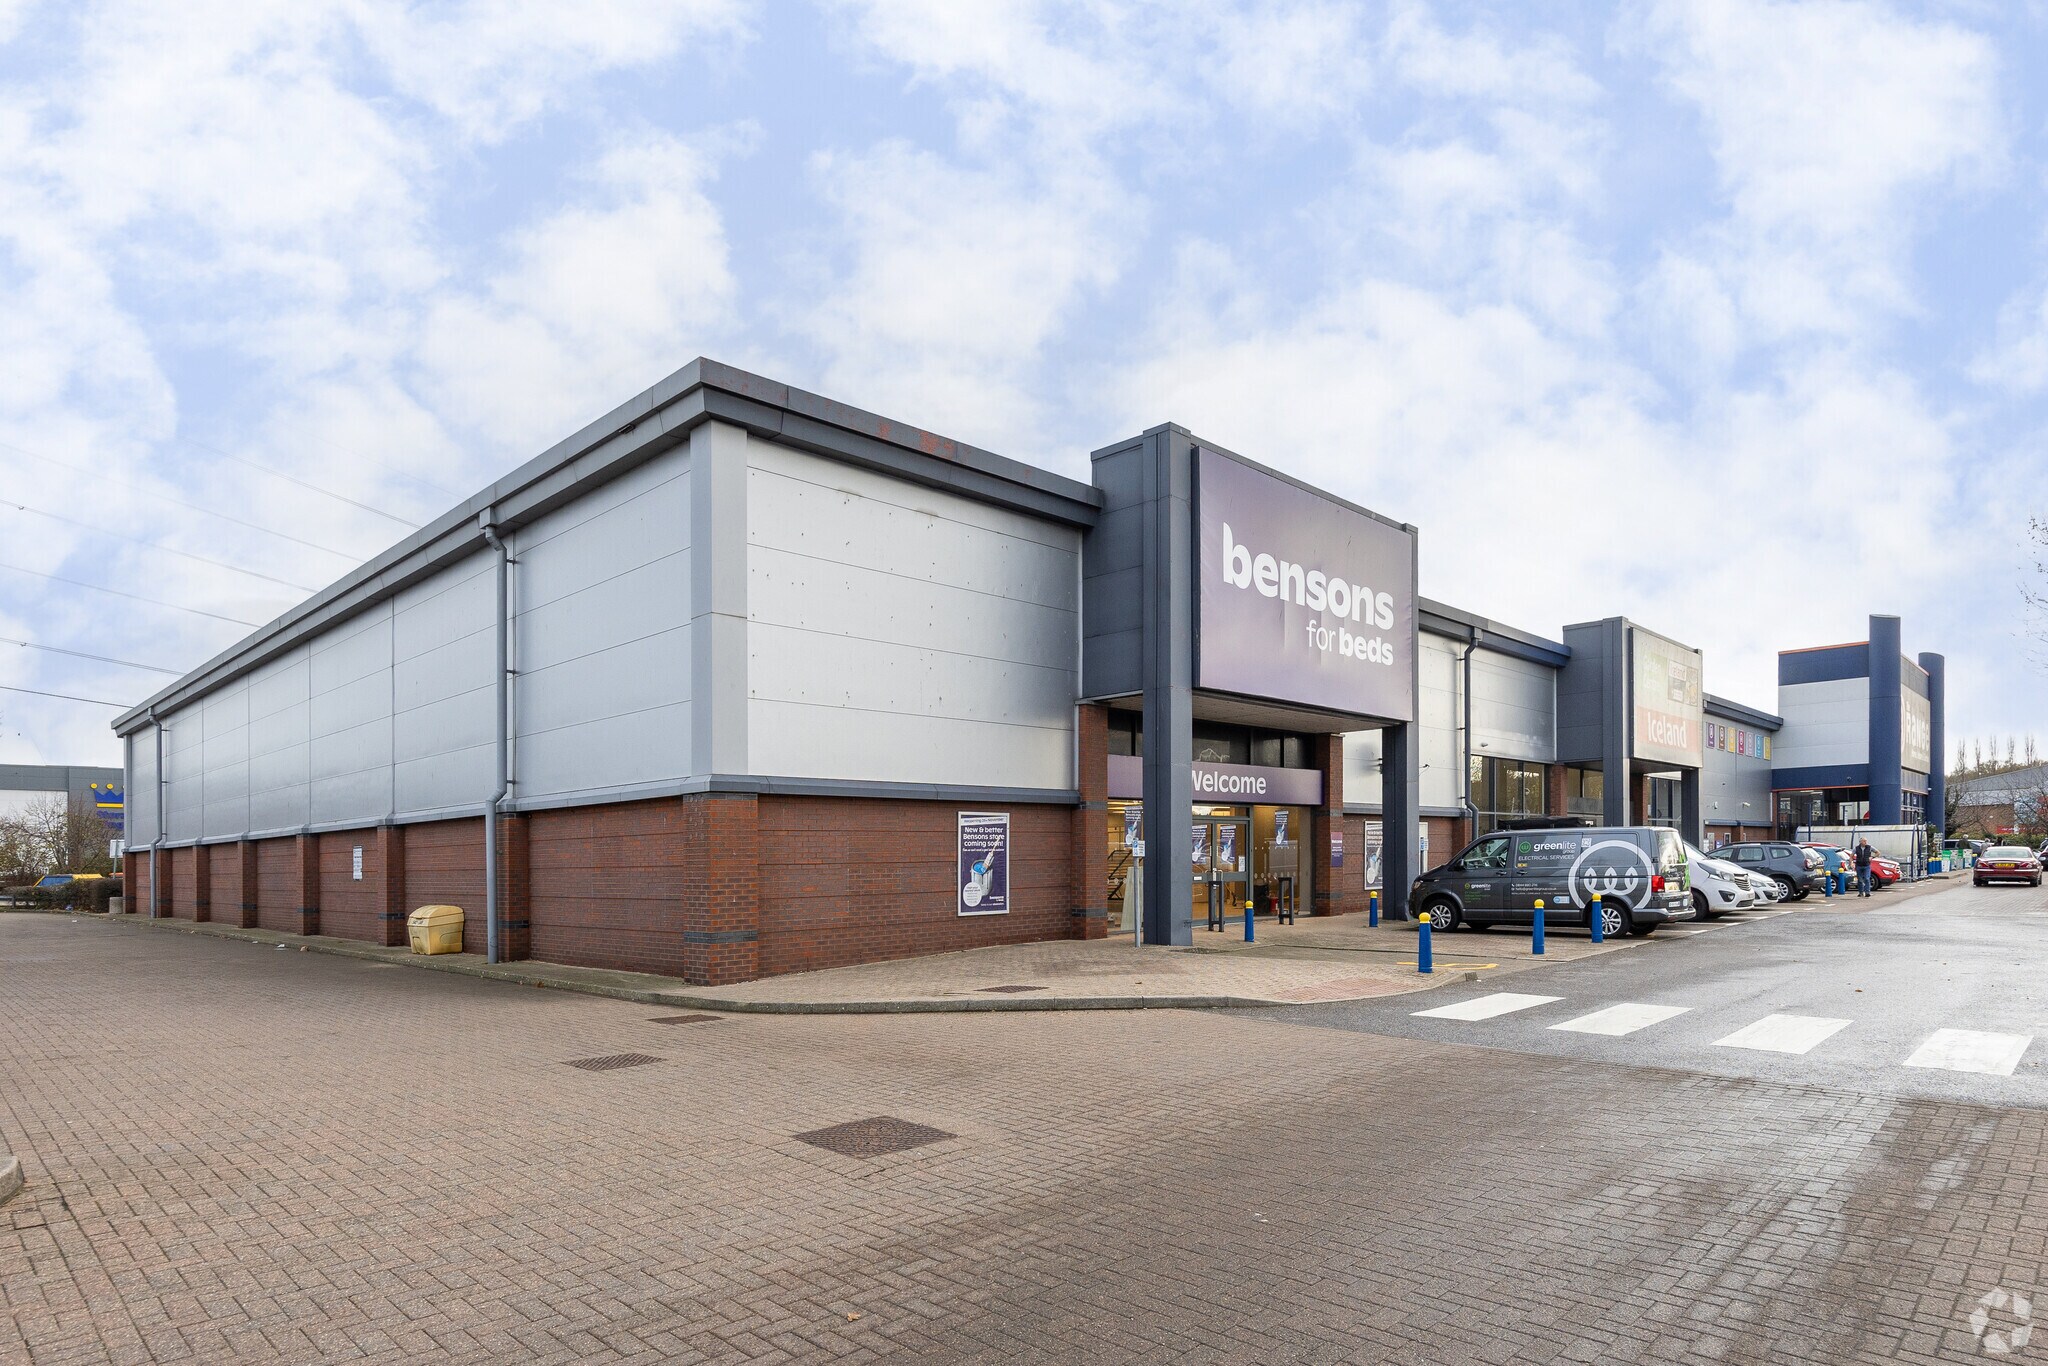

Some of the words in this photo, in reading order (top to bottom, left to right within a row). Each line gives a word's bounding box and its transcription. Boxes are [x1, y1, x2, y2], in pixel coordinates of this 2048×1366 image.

[1223, 521, 1394, 630] bensons
[1306, 619, 1336, 652] for
[1339, 627, 1394, 666] beds
[1647, 711, 1687, 749] Iceland
[1533, 840, 1577, 852] greenlite
